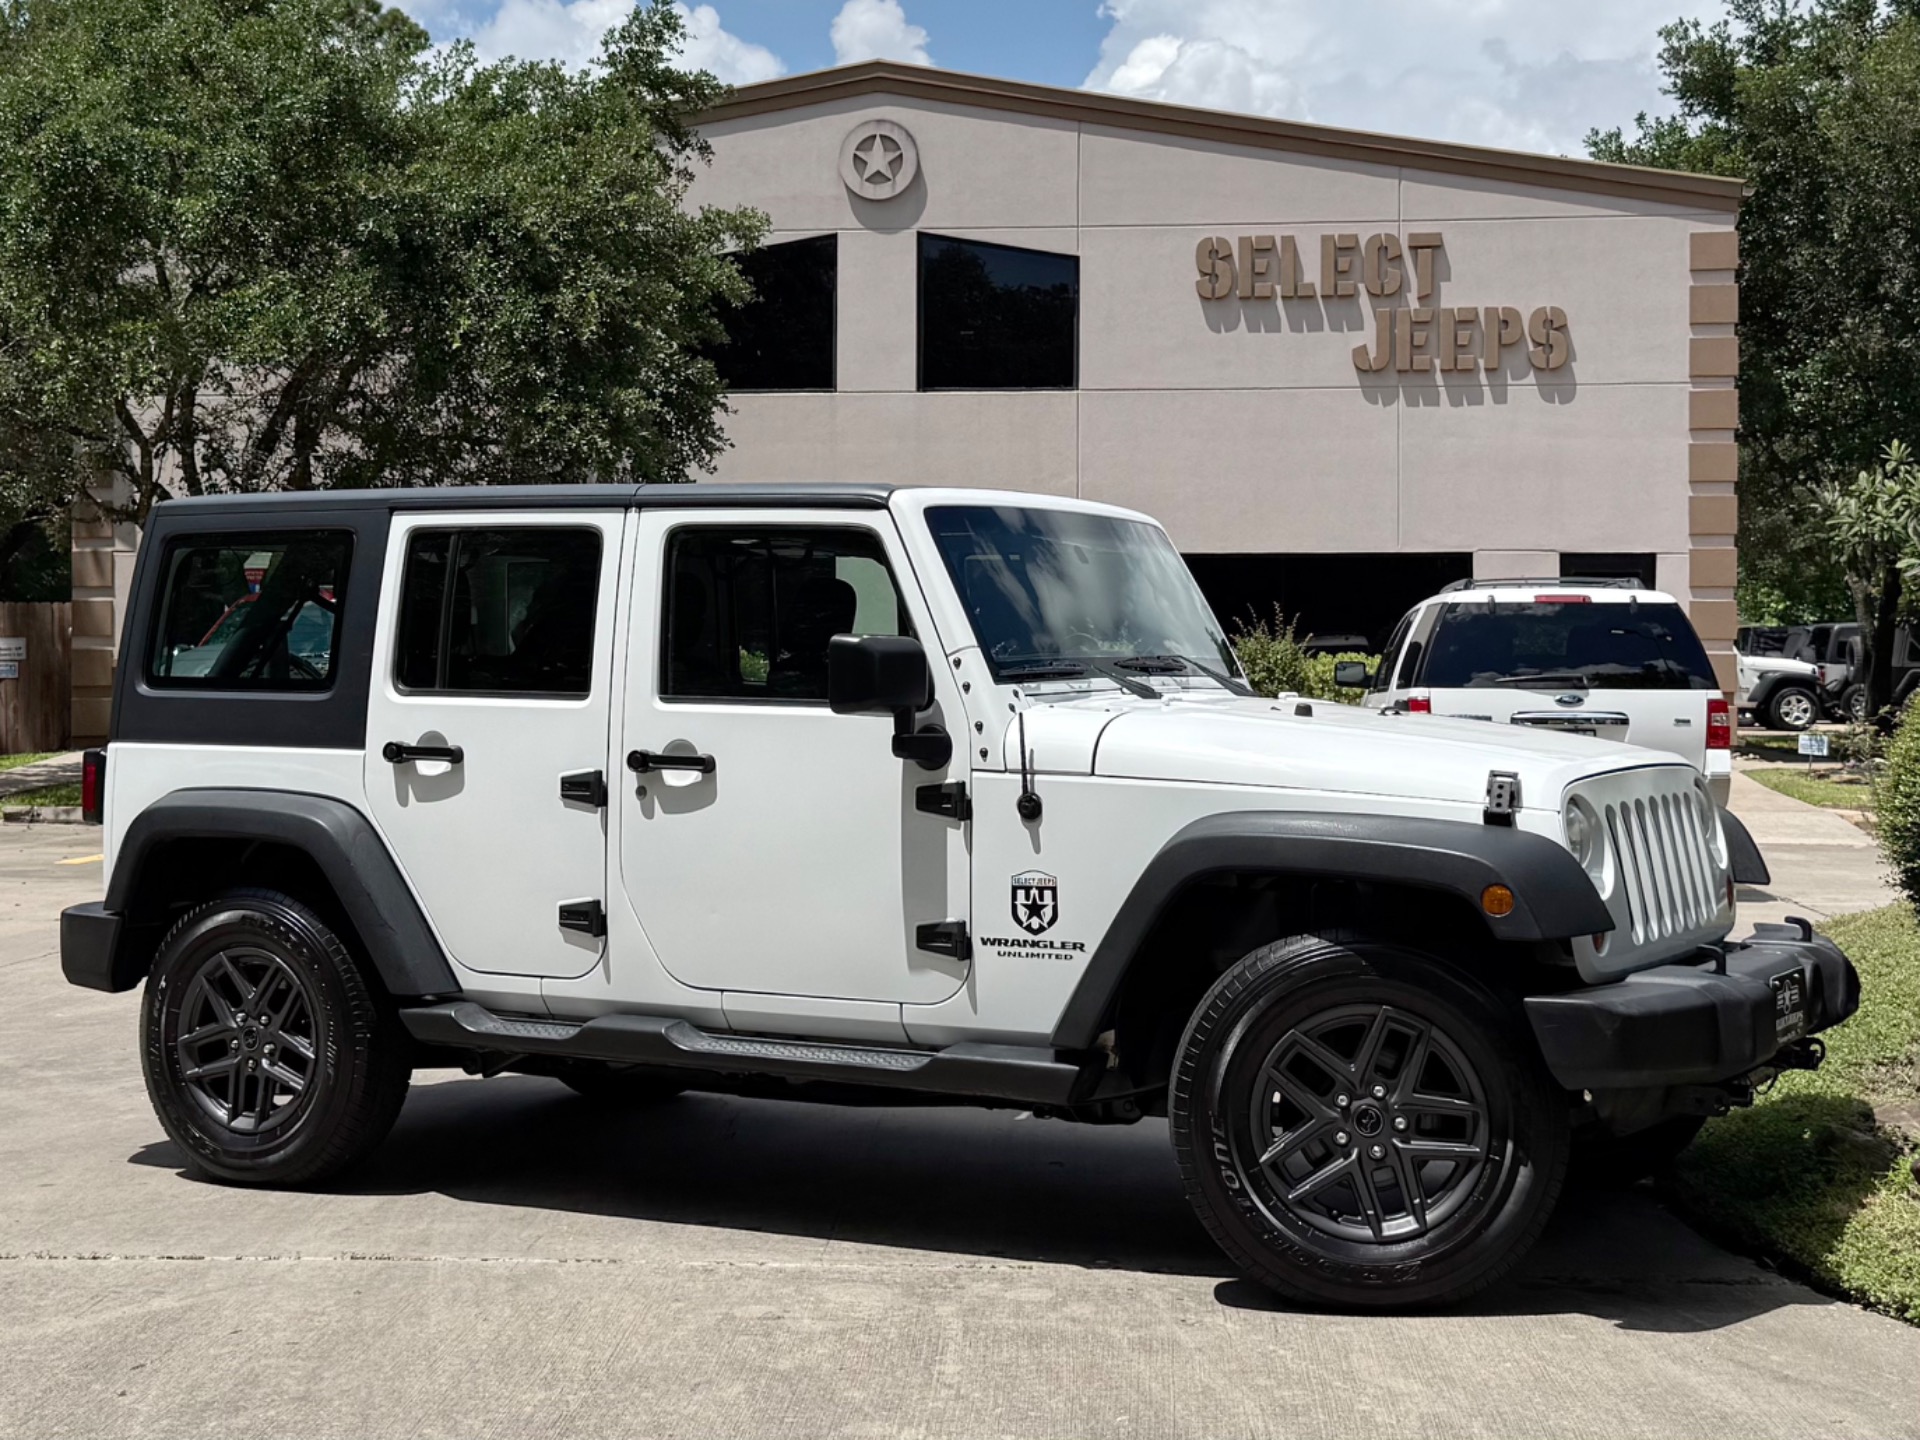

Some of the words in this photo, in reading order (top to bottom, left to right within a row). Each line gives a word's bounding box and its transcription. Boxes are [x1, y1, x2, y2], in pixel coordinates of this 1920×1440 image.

[1195, 232, 1444, 300] SELECT
[1352, 305, 1568, 372] JEEPS
[1013, 877, 1035, 885] SELECT
[1037, 877, 1056, 886] JEEPS
[980, 937, 1087, 952] WRANGLER
[997, 951, 1074, 960] UNLIMITED
